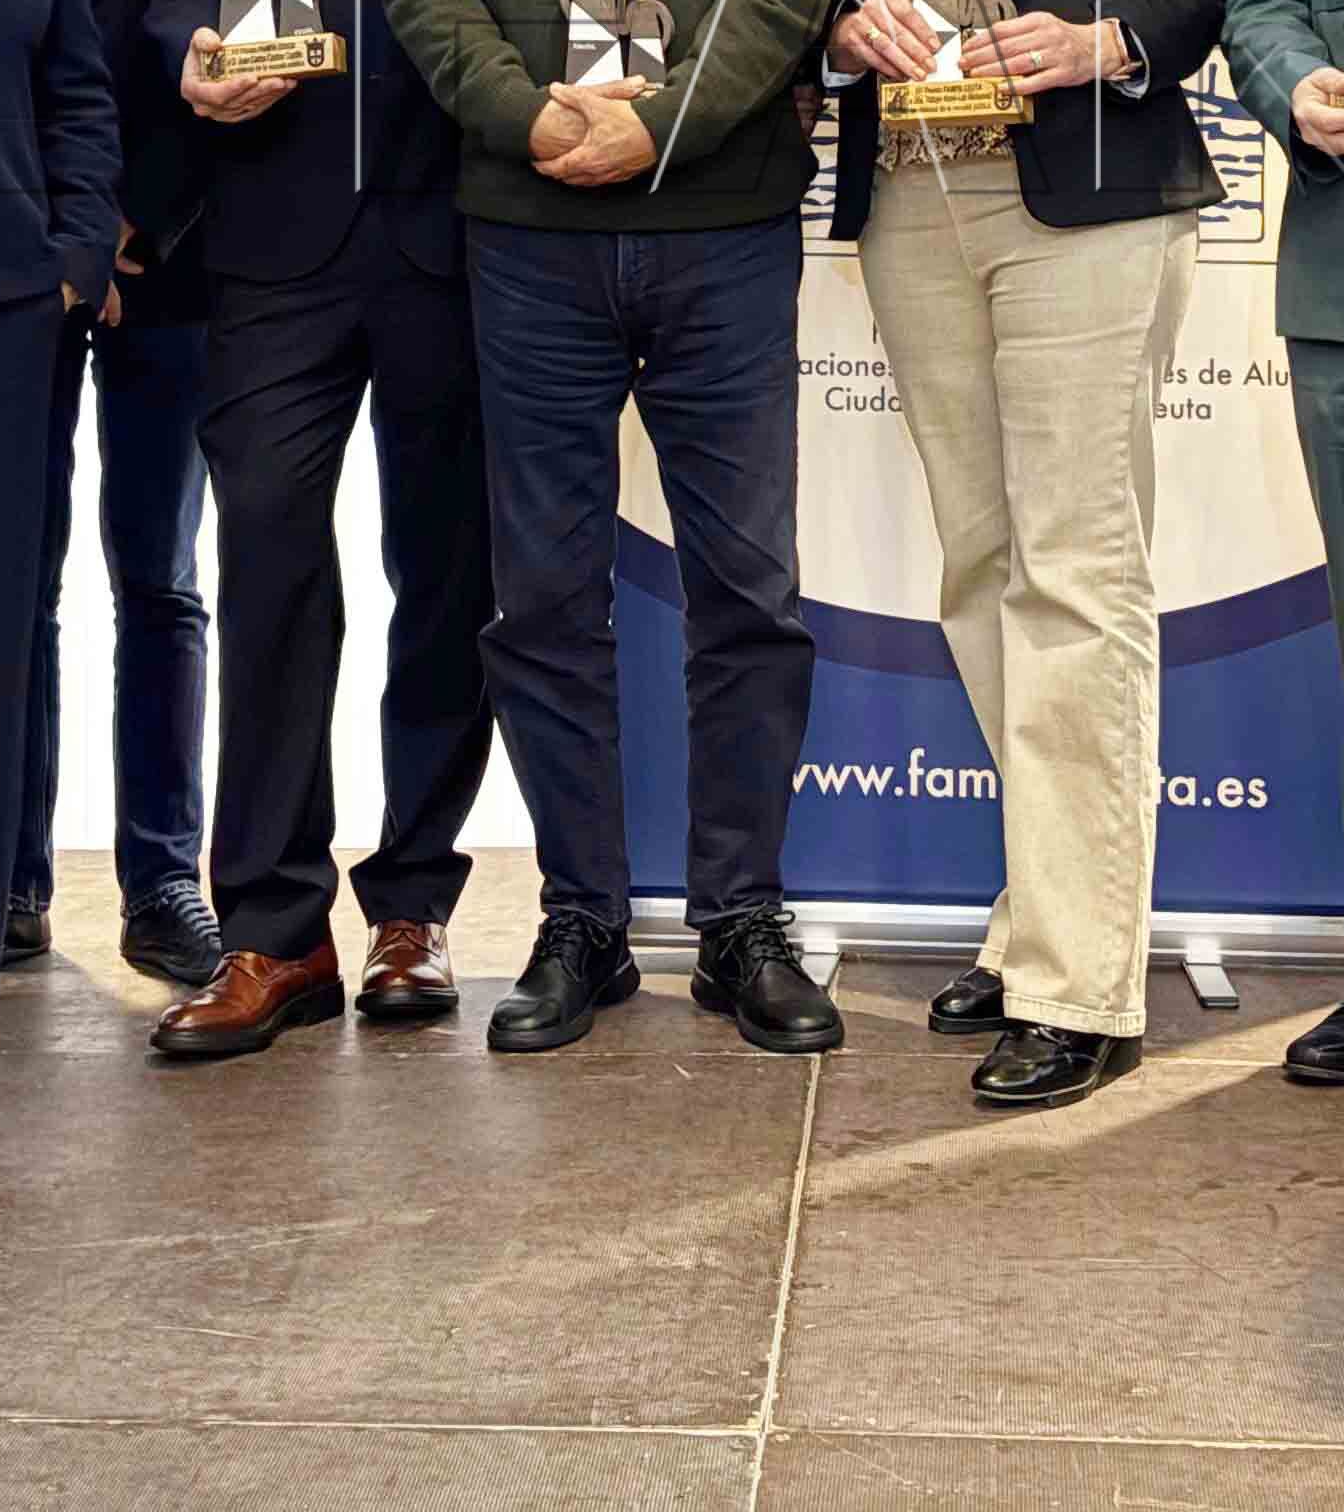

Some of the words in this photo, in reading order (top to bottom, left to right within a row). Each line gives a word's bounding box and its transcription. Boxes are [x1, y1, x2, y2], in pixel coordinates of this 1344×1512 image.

[1198, 357, 1232, 385] de
[1243, 359, 1289, 387] Alu
[1155, 398, 1212, 420] euta
